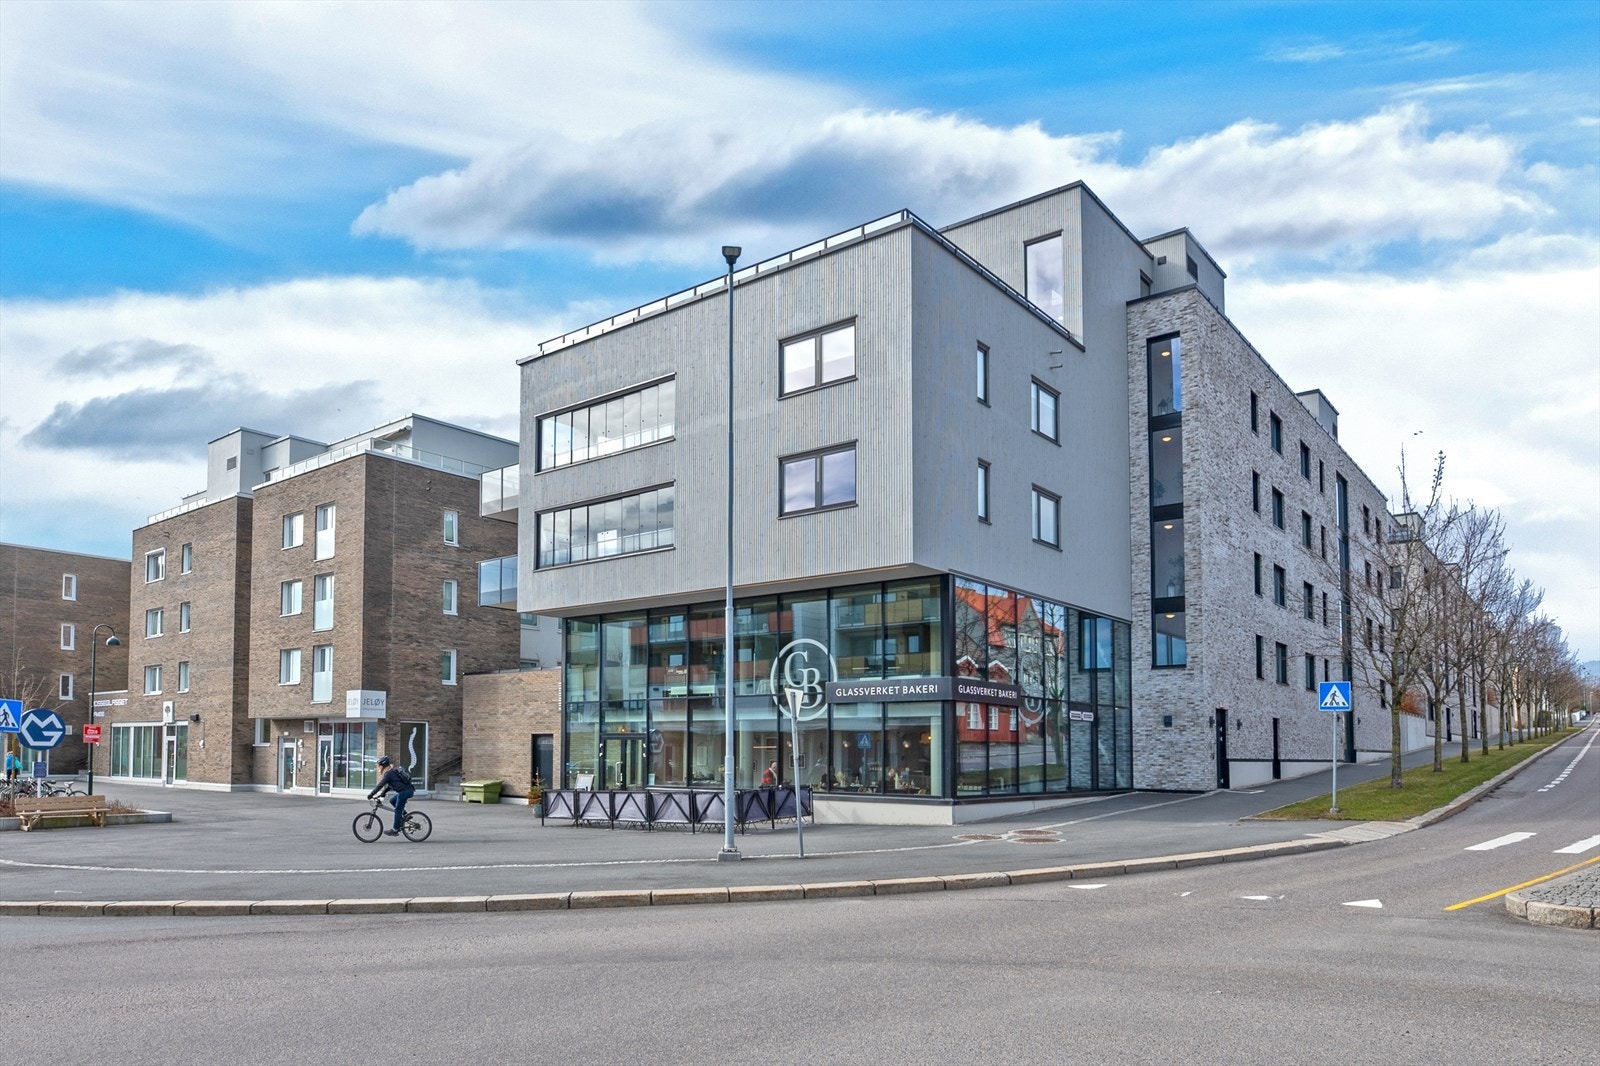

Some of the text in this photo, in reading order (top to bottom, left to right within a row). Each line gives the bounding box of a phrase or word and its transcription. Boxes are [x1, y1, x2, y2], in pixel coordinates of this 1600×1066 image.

[835, 684, 938, 697] GLASSVERKET BAKERI
[958, 684, 1018, 699] GLASSVERKET BAKERI
[362, 698, 385, 706] JELØY
